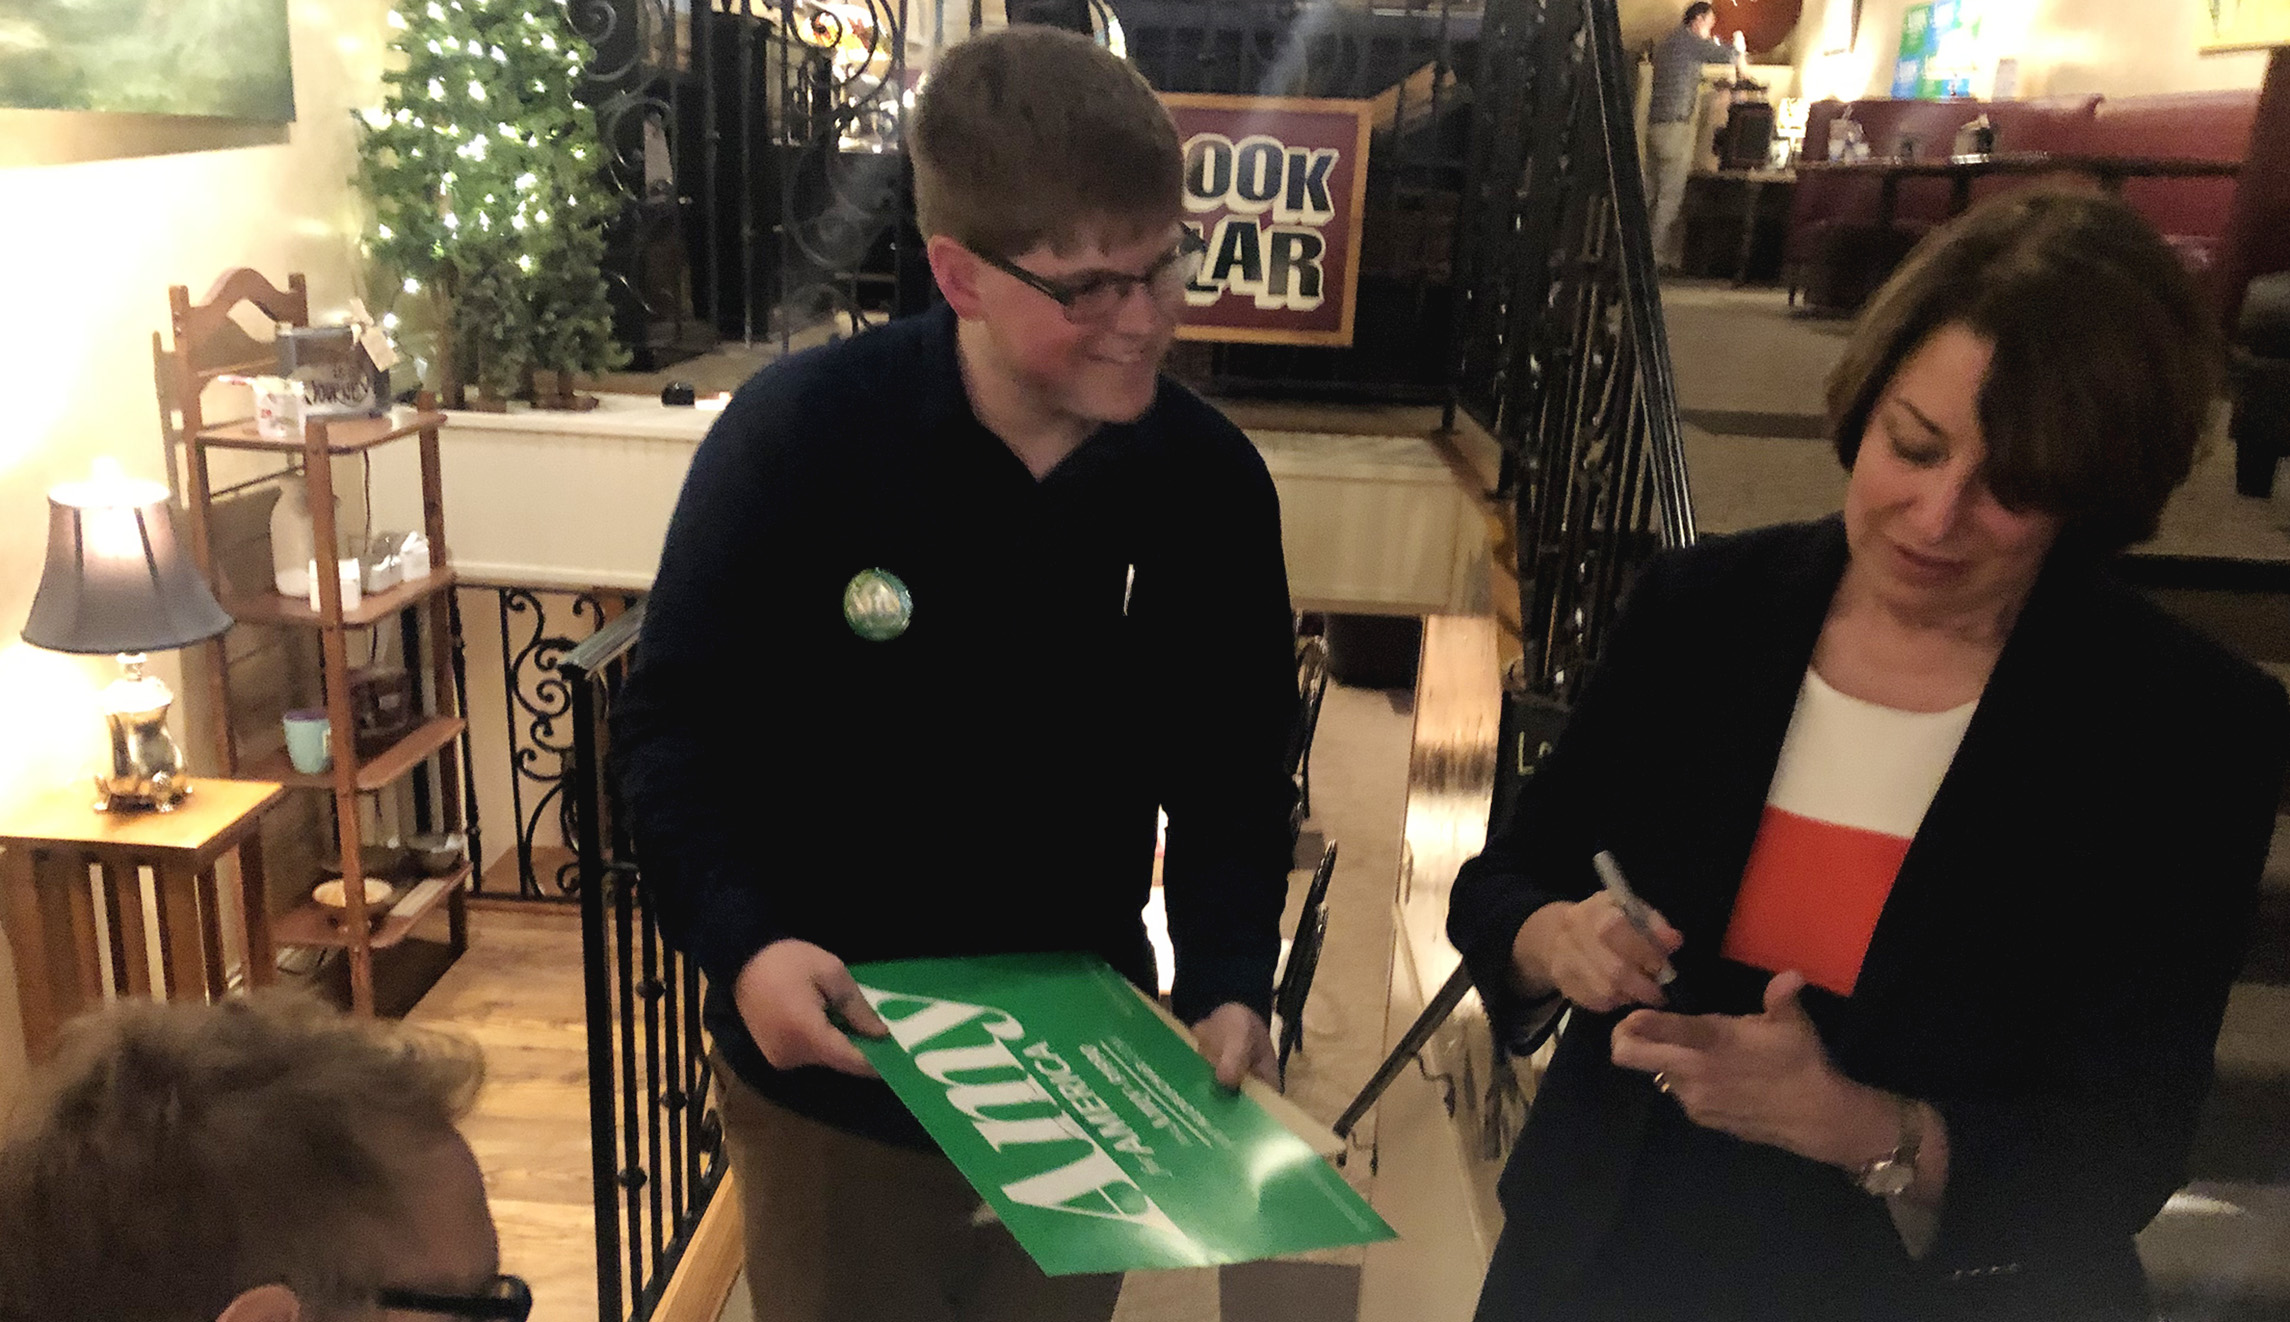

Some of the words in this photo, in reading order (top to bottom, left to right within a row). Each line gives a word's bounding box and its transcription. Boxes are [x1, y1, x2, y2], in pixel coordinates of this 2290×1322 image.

[1182, 133, 1340, 225] OOK
[856, 984, 1207, 1264] Amy
[1023, 1041, 1154, 1155] AMERICA
